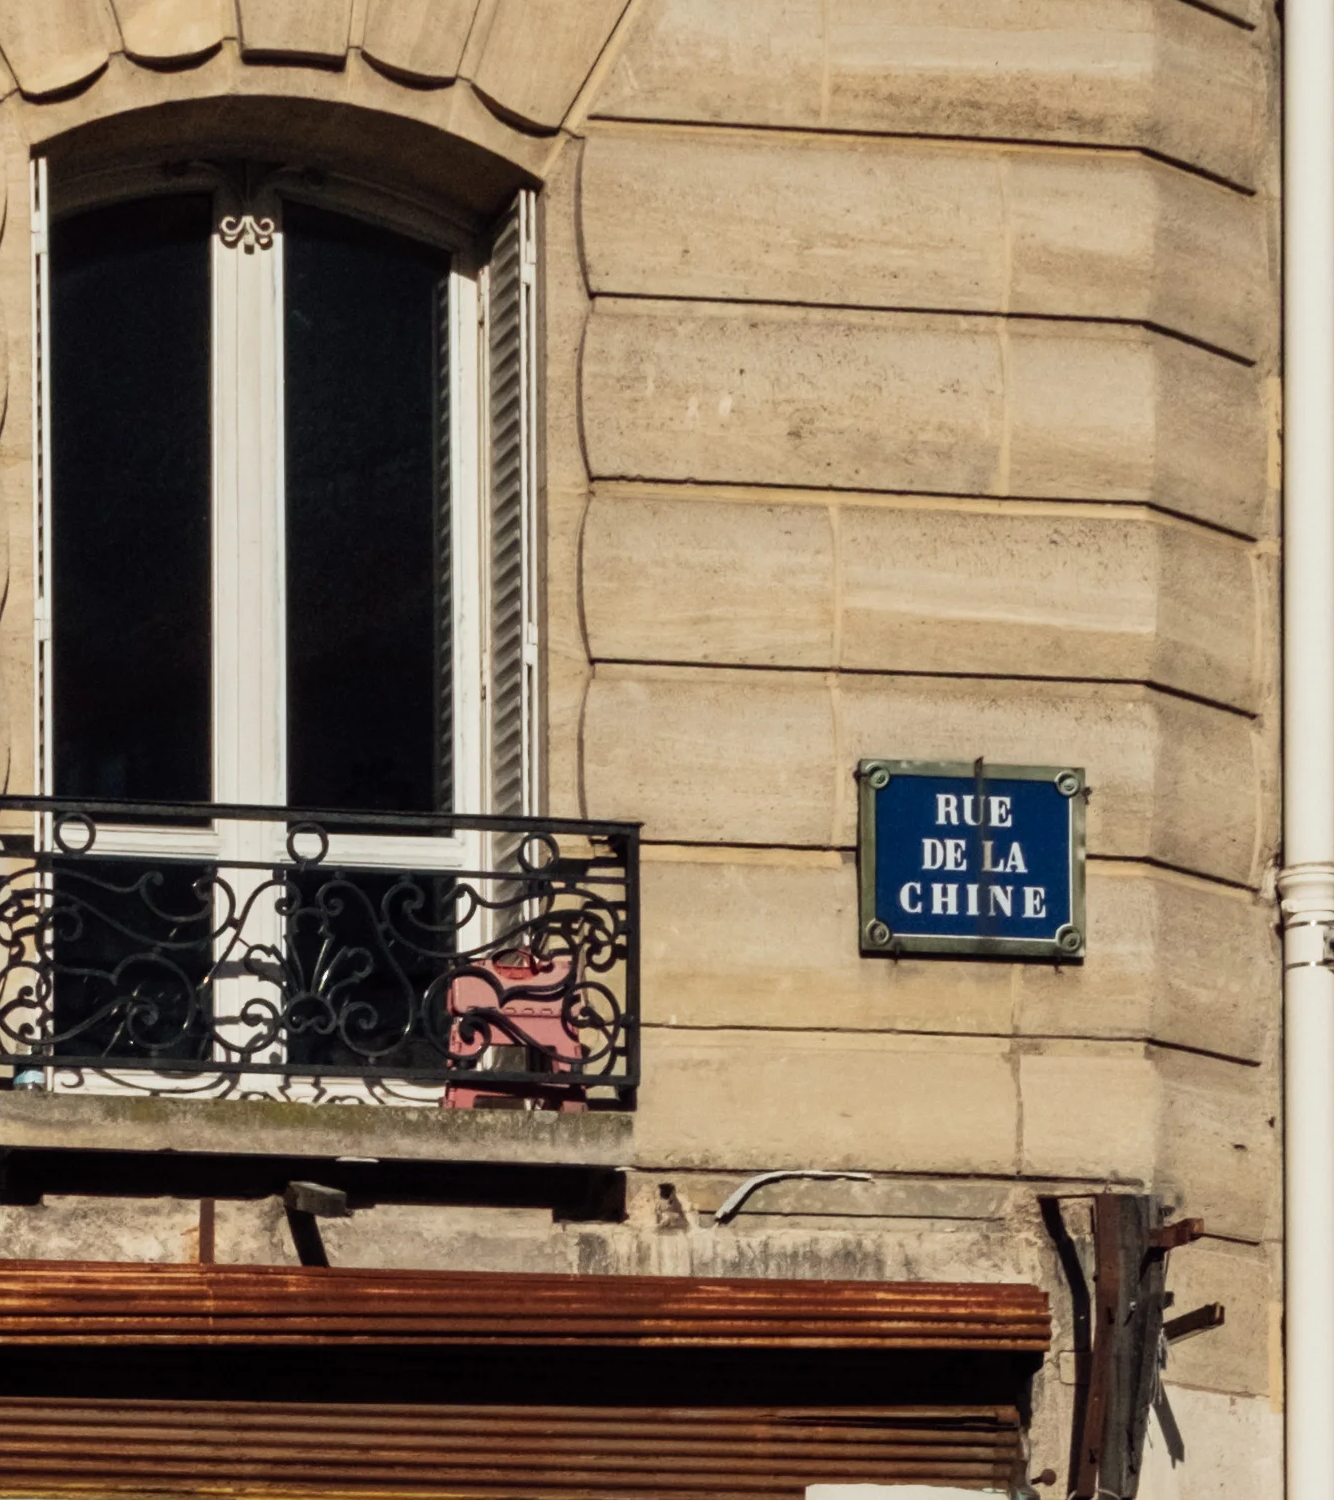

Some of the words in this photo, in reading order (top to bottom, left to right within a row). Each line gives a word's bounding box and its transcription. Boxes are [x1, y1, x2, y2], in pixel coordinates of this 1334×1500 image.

[935, 793, 1013, 827] RUE
[921, 838, 967, 871] DE
[982, 840, 1028, 874] LA
[899, 881, 1047, 918] CHINE
